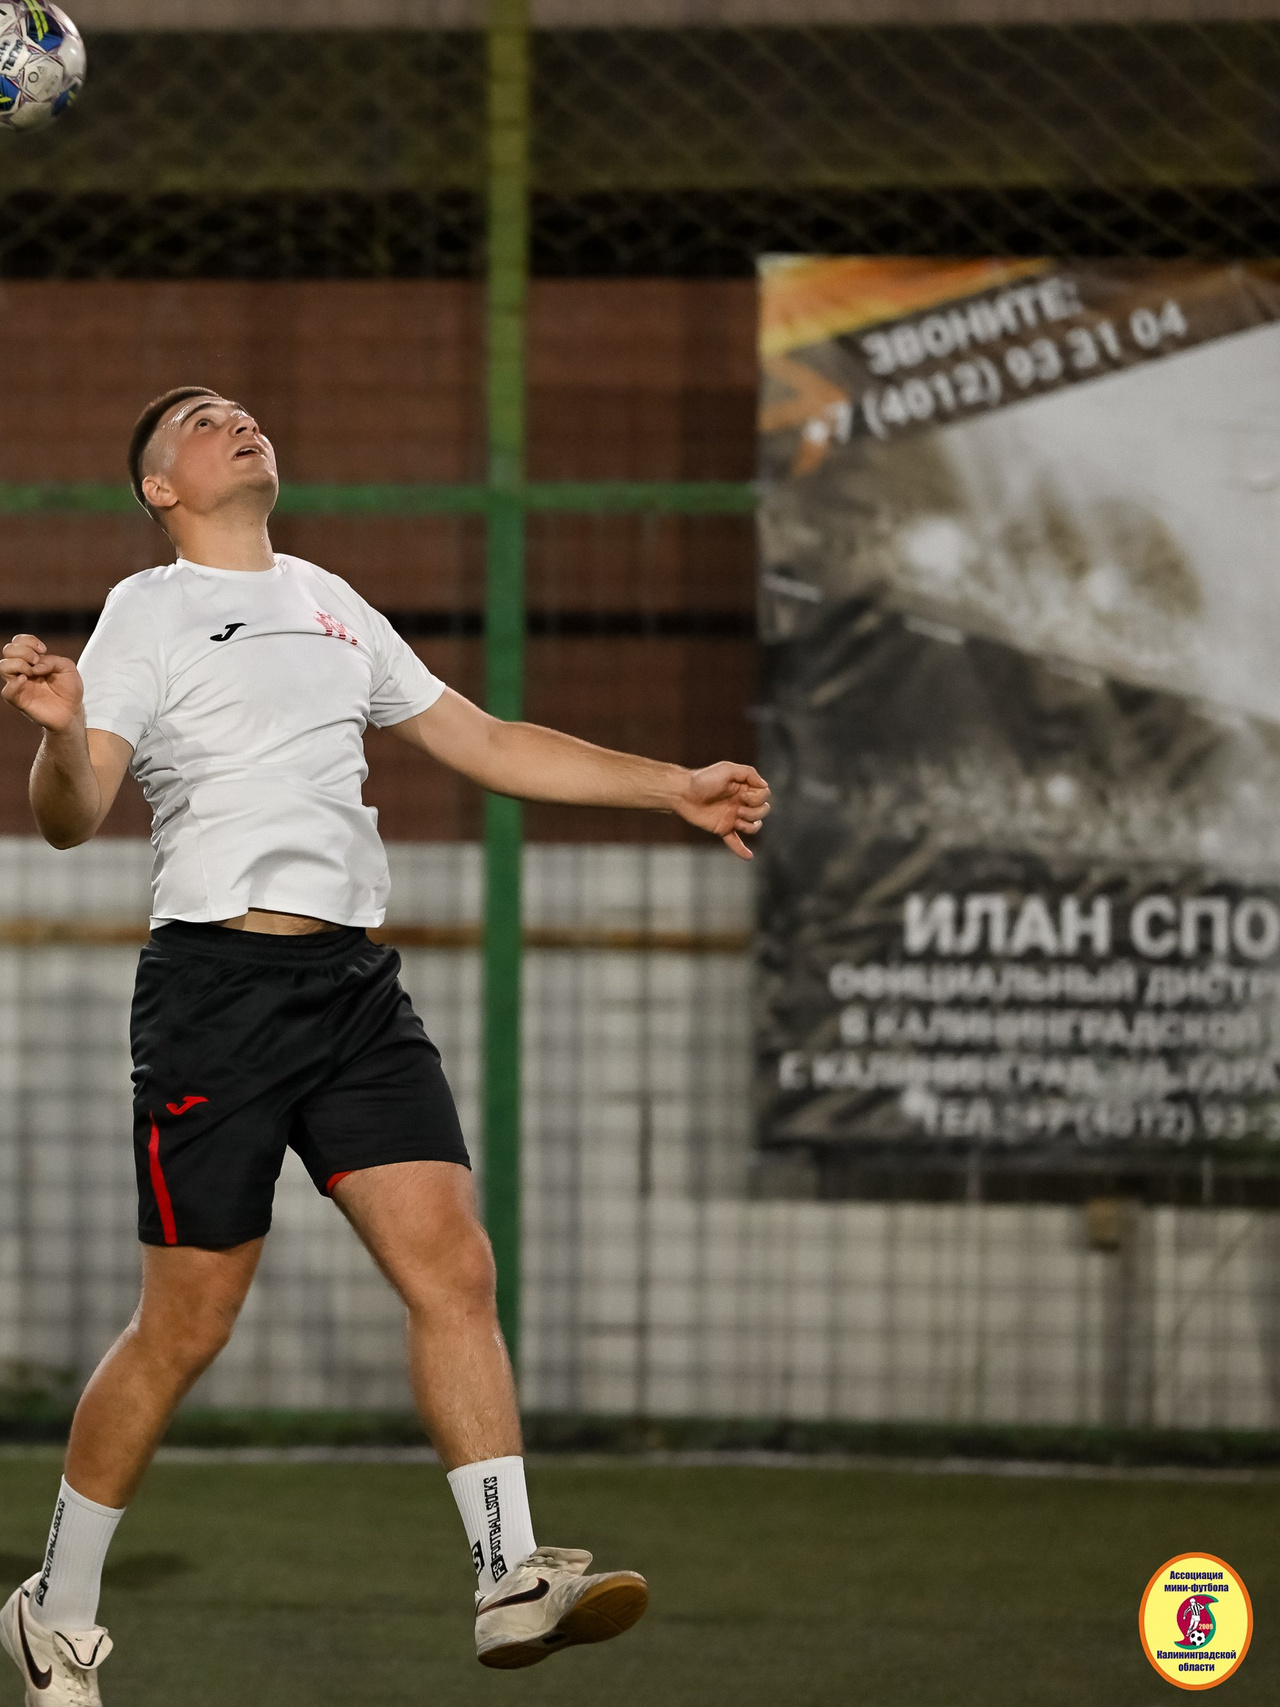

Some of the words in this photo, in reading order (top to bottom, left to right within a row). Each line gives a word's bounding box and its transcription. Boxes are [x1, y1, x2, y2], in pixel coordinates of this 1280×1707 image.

[863, 353, 1002, 440] (4012)
[1005, 337, 1063, 389] 93
[1065, 318, 1122, 371] 31
[1129, 299, 1188, 350] 04
[903, 893, 1112, 956] ИЛАН
[1129, 895, 1280, 961] СПО
